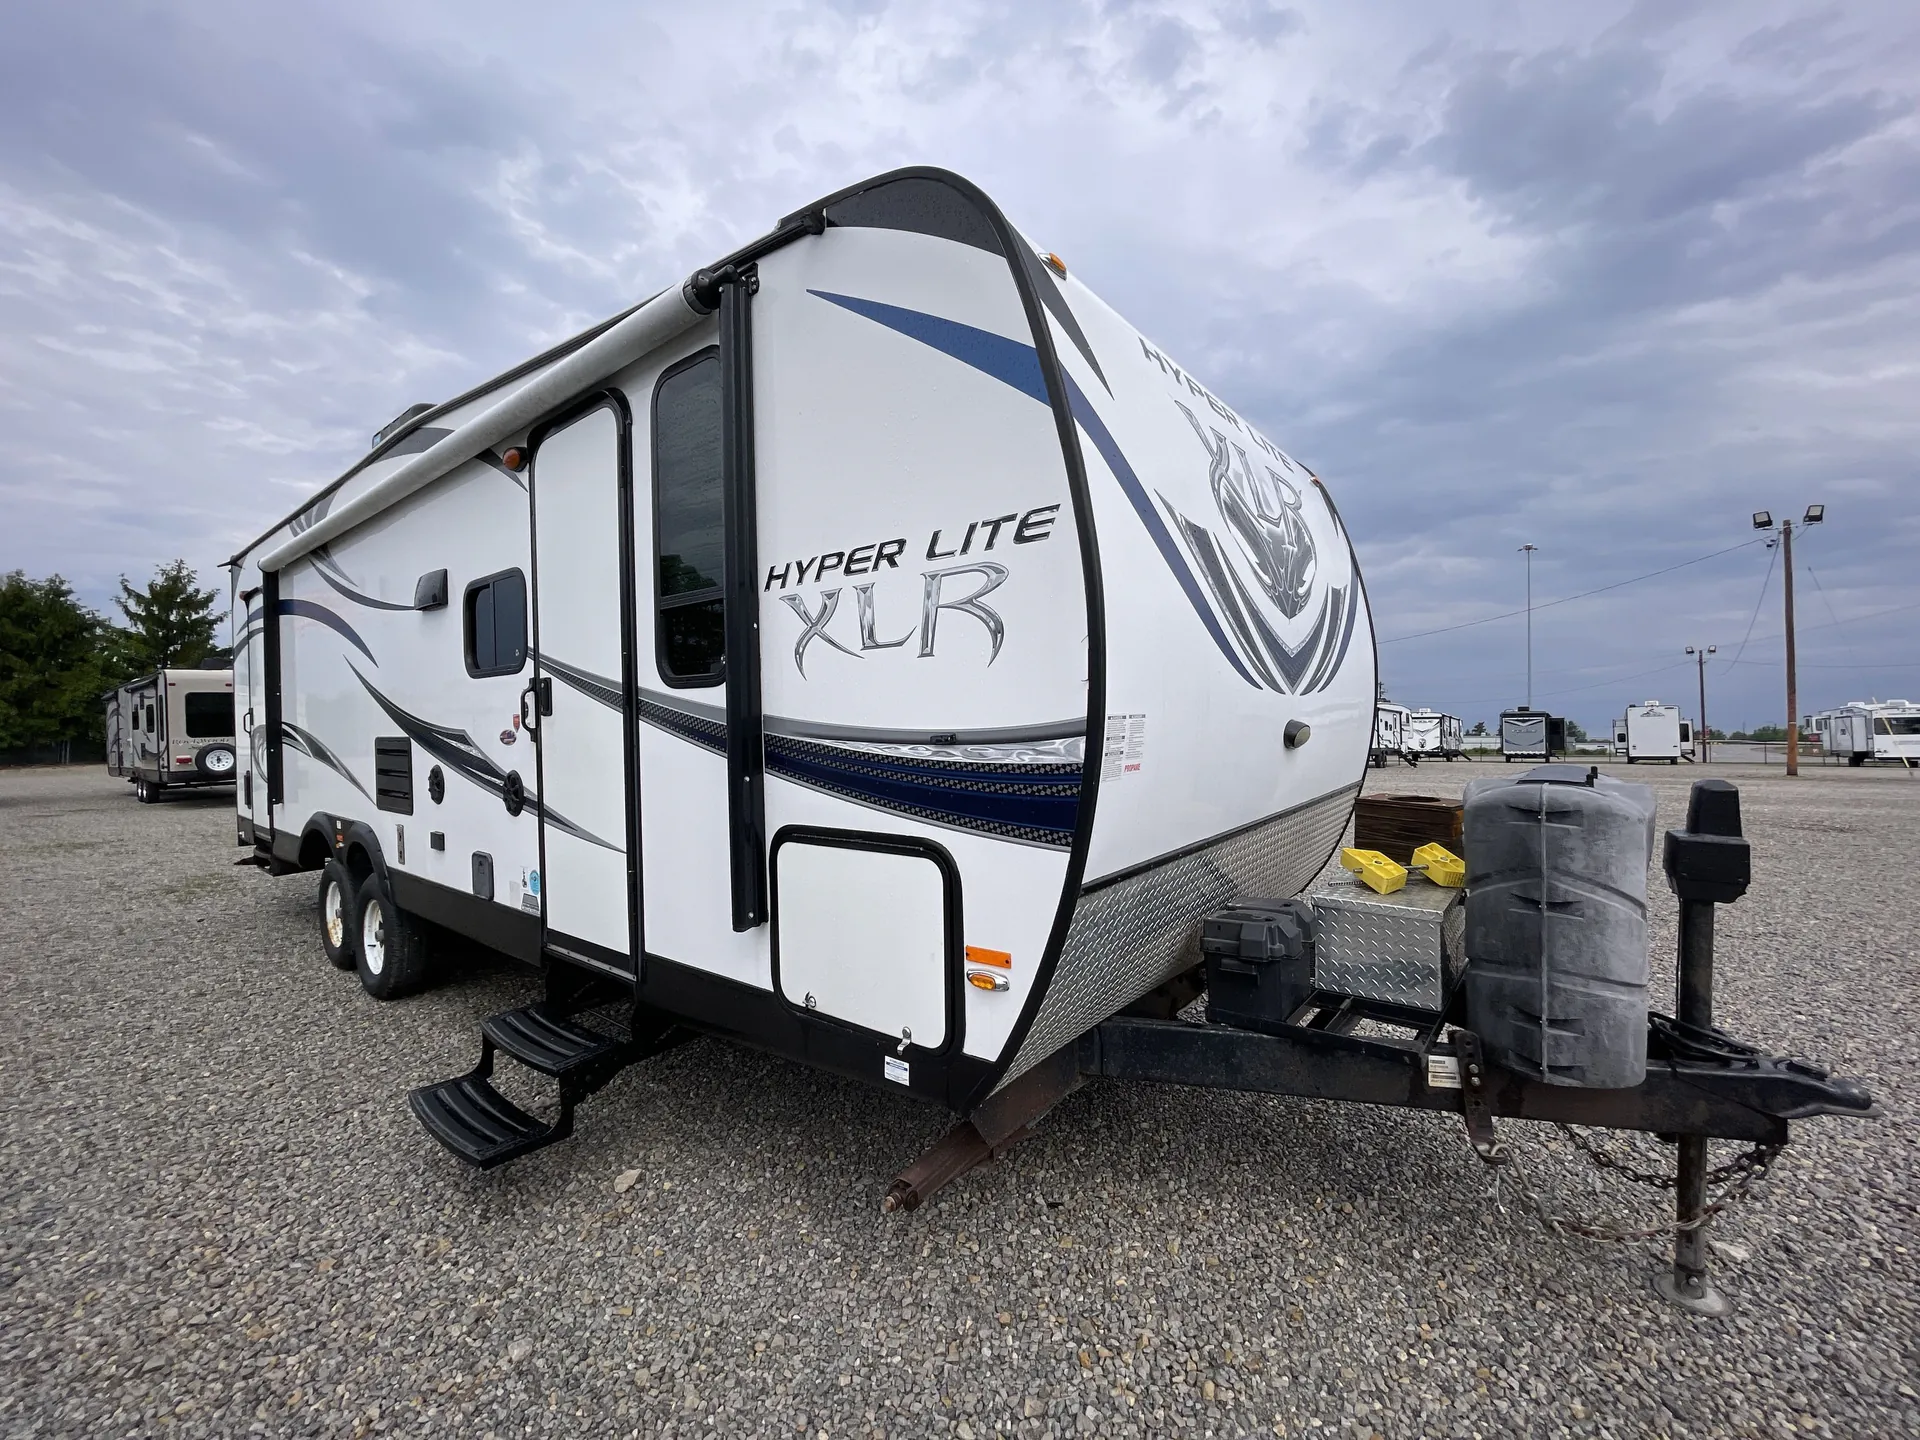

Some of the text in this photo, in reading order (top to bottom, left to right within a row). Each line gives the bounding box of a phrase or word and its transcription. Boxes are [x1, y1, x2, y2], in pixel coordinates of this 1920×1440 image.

[1138, 336, 1294, 473] HYPER LITE
[764, 504, 1061, 592] HYPER LITE
[1174, 400, 1317, 572] XLR
[779, 561, 1009, 681] XLR
